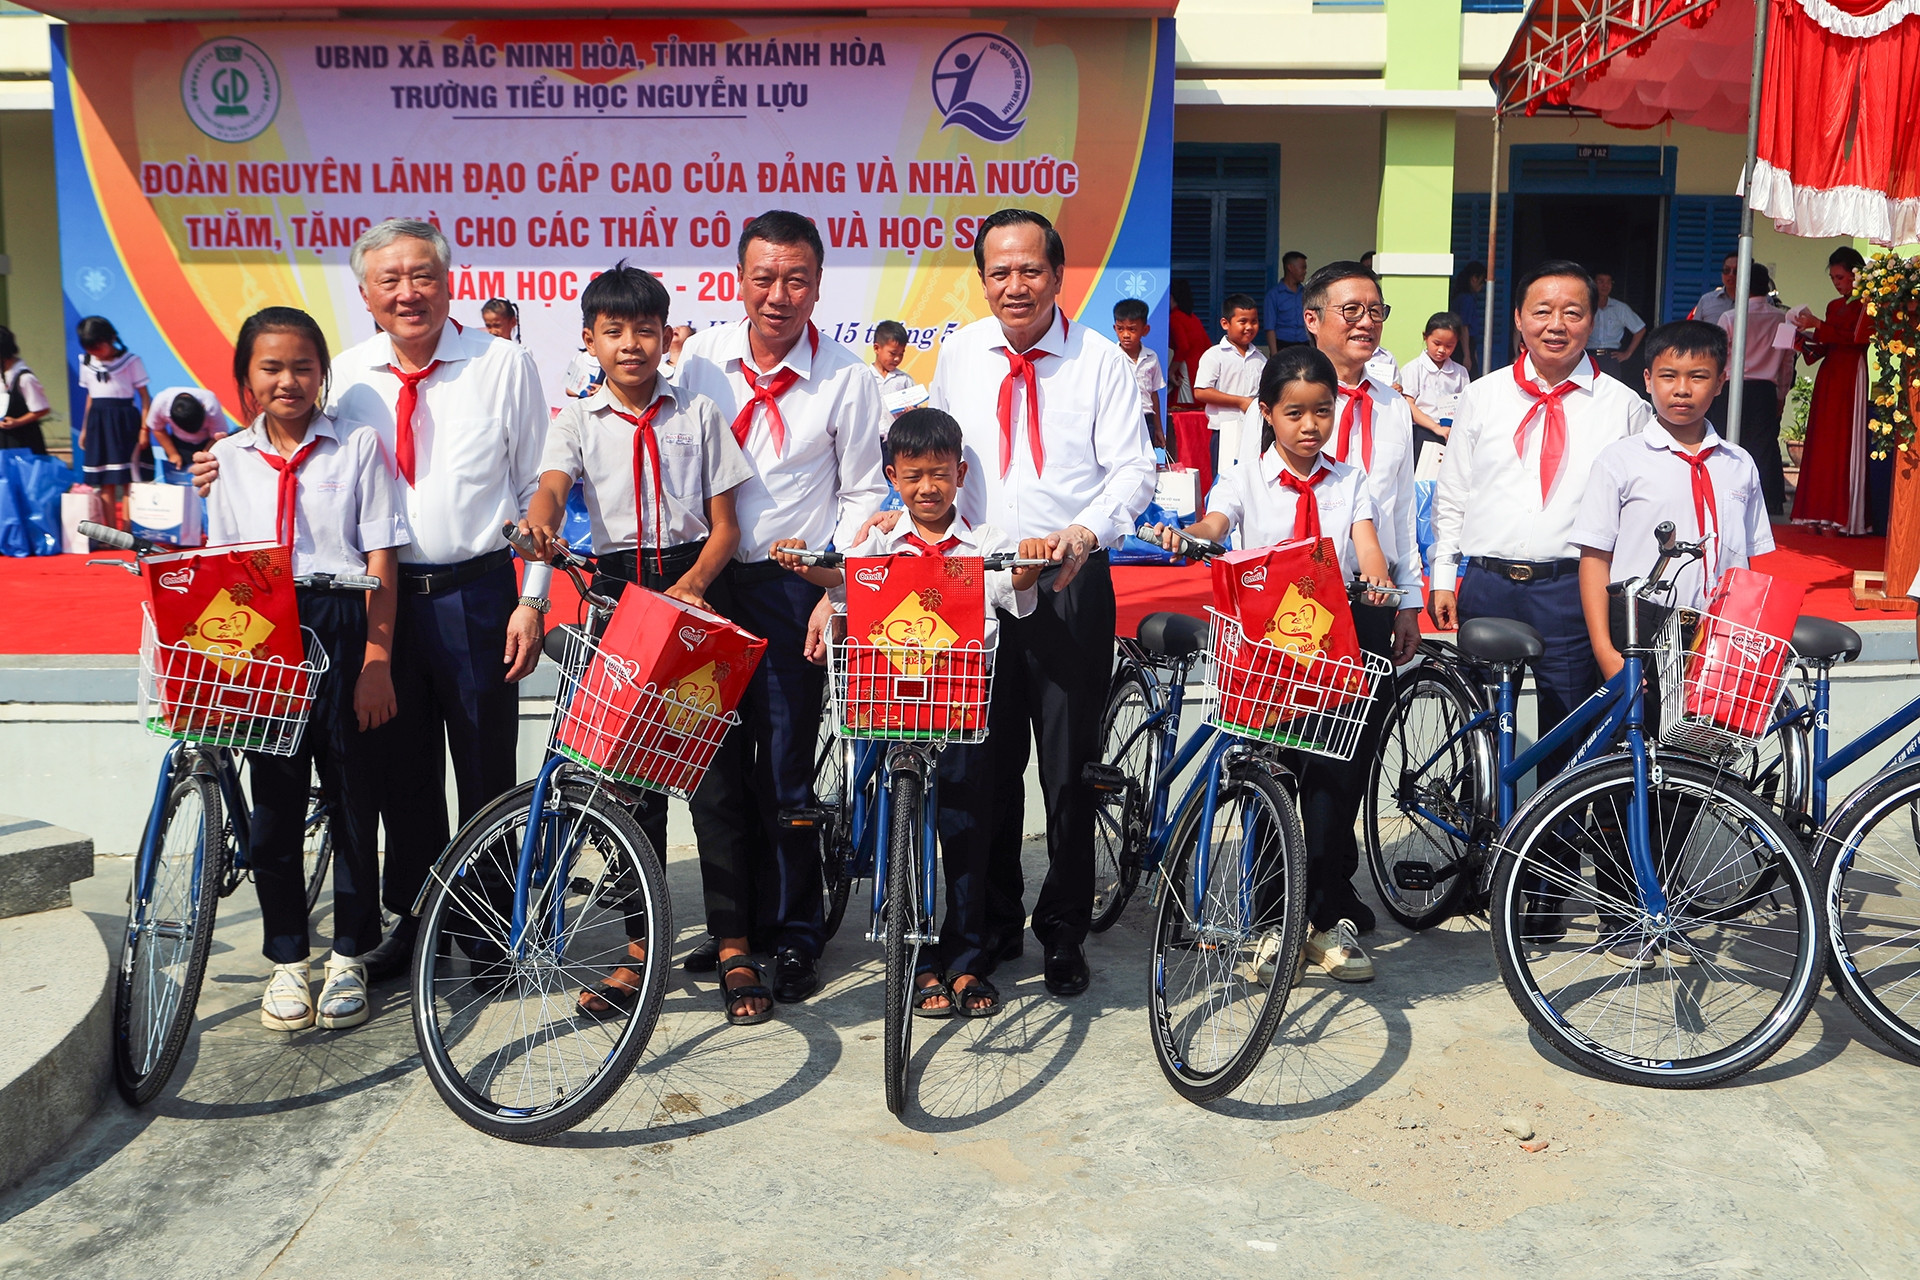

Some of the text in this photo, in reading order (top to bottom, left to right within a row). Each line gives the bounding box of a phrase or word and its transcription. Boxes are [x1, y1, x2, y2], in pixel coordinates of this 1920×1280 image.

[315, 34, 886, 70] UBND XÃ BẮC NINH HÒA, TỈNH KHÁNH HÒA
[391, 75, 808, 113] TRƯỜNG TIỂU HỌC NGUYỄN LỰU
[143, 151, 1078, 200] ĐOÀN NGUYÊN LÃNH ĐẠO CẤP CAO CỦA ĐẢNG VÀ NHÀ NƯỚC
[186, 211, 282, 250] THĂM,
[455, 216, 516, 247] CHO
[528, 210, 590, 247] CÁC
[600, 206, 678, 247] THẦY
[689, 210, 731, 247] CÔ
[827, 211, 868, 248] VÀ
[879, 217, 943, 255] HỌC
[517, 271, 578, 307] HỌC
[698, 272, 744, 301] 20
[834, 322, 860, 343] 15
[865, 322, 937, 350] tng
